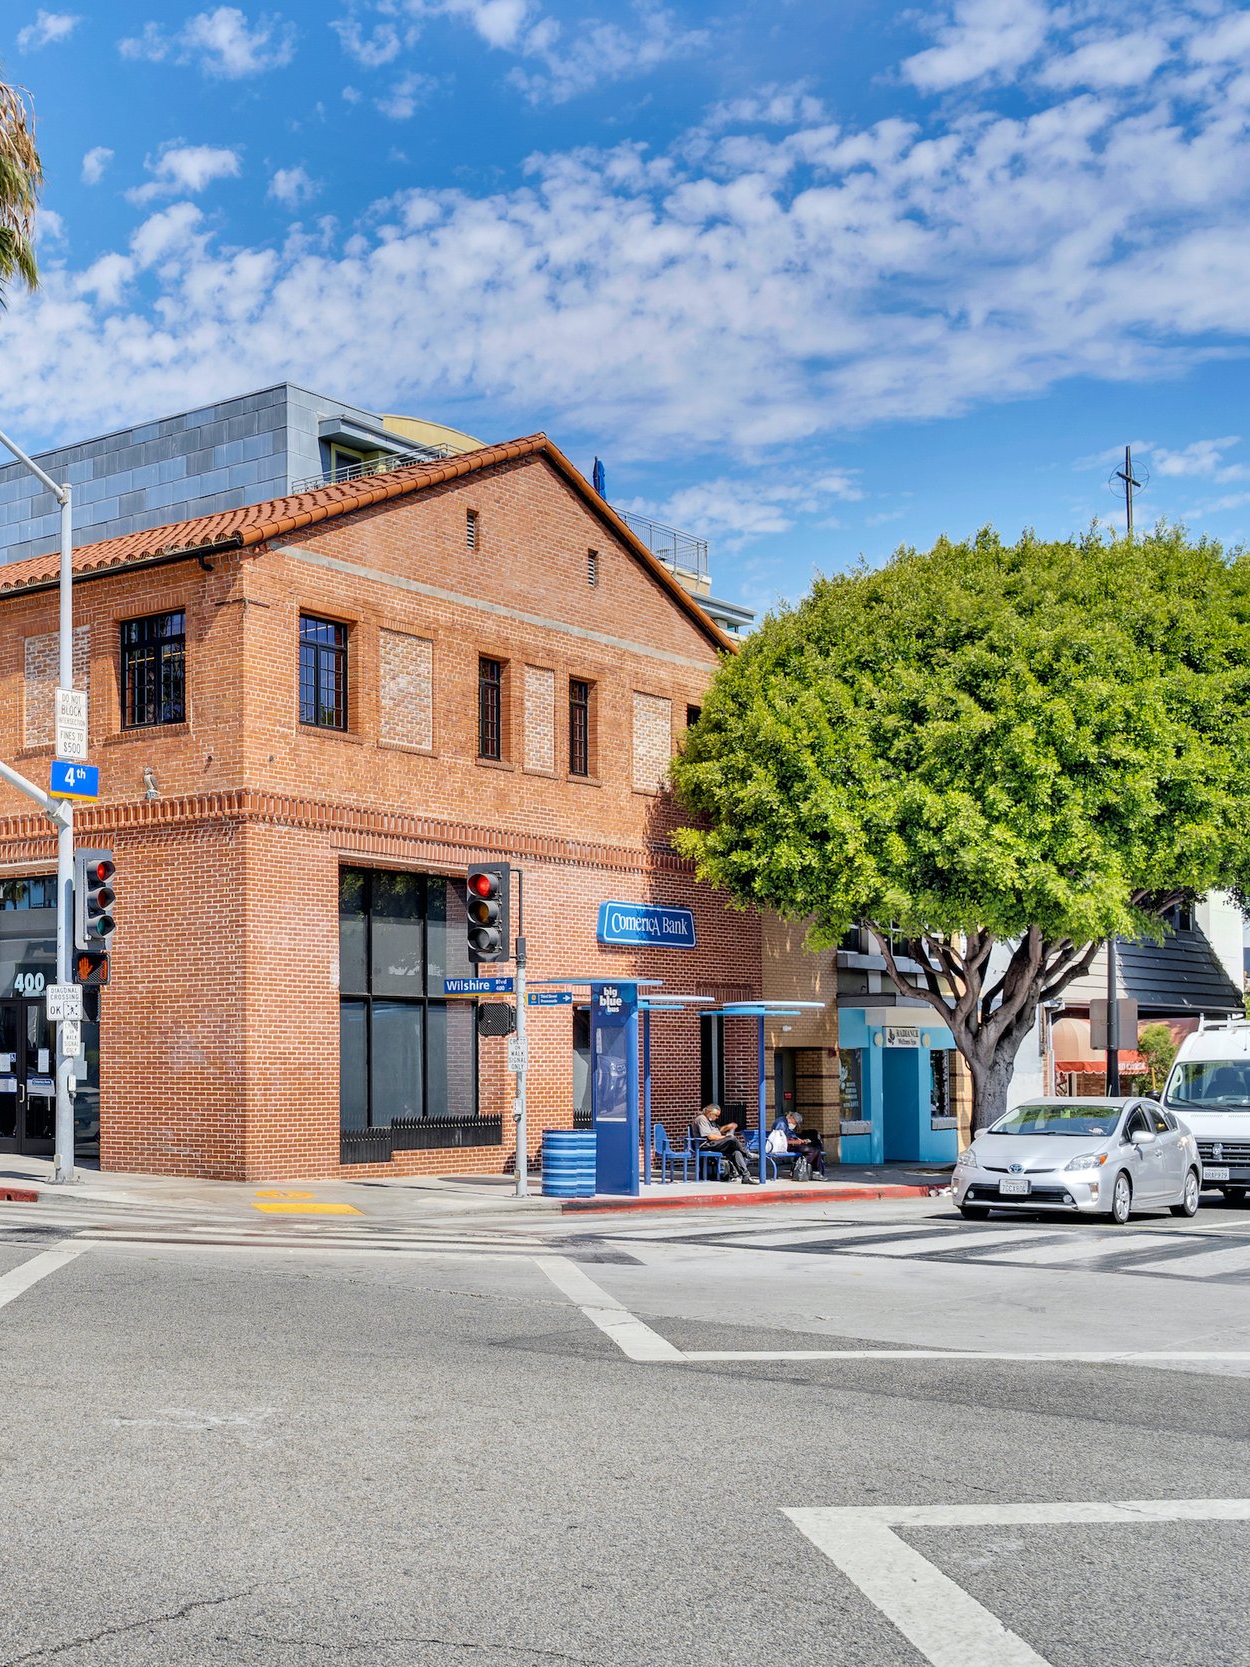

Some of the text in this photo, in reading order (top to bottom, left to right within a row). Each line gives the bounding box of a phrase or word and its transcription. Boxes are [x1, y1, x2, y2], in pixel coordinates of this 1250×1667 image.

[61, 693, 81, 705] DO NOT
[61, 704, 82, 717] BLOCK
[61, 730, 84, 742] FINES TO
[63, 741, 81, 754] $500
[64, 767, 86, 787] 4th
[662, 916, 688, 935] Bank
[14, 972, 45, 993] 400
[446, 980, 490, 991] Wilshire
[603, 986, 618, 998] big
[599, 995, 623, 1007] blue
[50, 1005, 62, 1015] OK
[607, 1005, 620, 1013] bus
